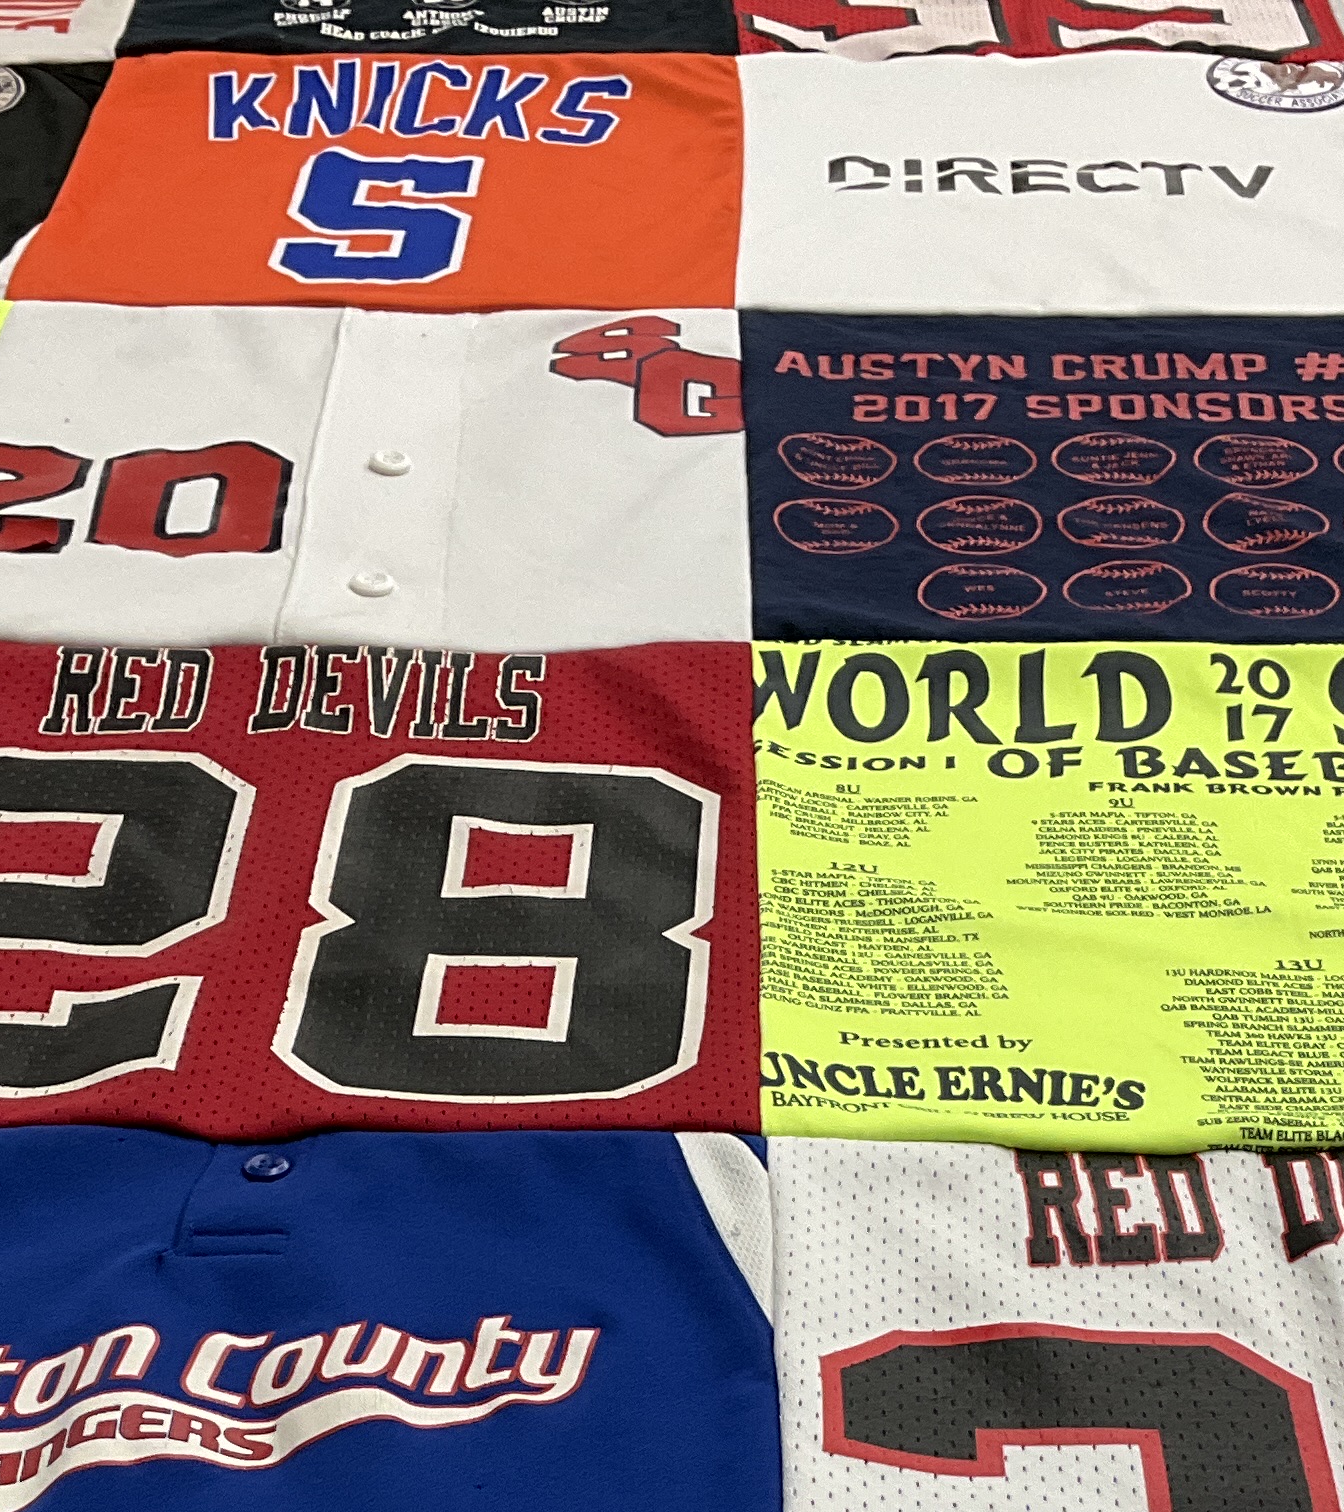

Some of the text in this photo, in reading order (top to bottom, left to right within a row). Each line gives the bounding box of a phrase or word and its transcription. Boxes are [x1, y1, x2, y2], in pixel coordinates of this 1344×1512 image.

[208, 58, 632, 146] KNICKS
[827, 155, 1275, 200] DIRECTV
[267, 146, 484, 283] 5
[774, 351, 1028, 382] AUSTYN
[1051, 352, 1269, 383] CRUMP
[852, 392, 994, 424] 2017
[1210, 652, 1292, 701] 20
[39, 643, 549, 744] RED DEVILS
[752, 648, 1173, 746] WORLD
[1226, 703, 1293, 744] 17
[987, 746, 1084, 779] OF
[835, 783, 862, 795] 8U
[1088, 781, 1194, 793] FRANK
[1206, 783, 1322, 797] BROWN
[1108, 797, 1136, 809] 9U
[829, 861, 879, 875] 12U
[803, 889, 846, 897] STORM
[1274, 958, 1326, 971] 13U
[837, 1030, 1034, 1053] Presented by
[771, 1091, 892, 1114] BAYFRONT
[933, 1064, 1147, 1111] ERNIE'S
[1240, 1127, 1273, 1141] TEAM
[1277, 1130, 1312, 1142] ELITE
[1014, 1149, 1224, 1268] RED
[180, 1314, 601, 1410] County
